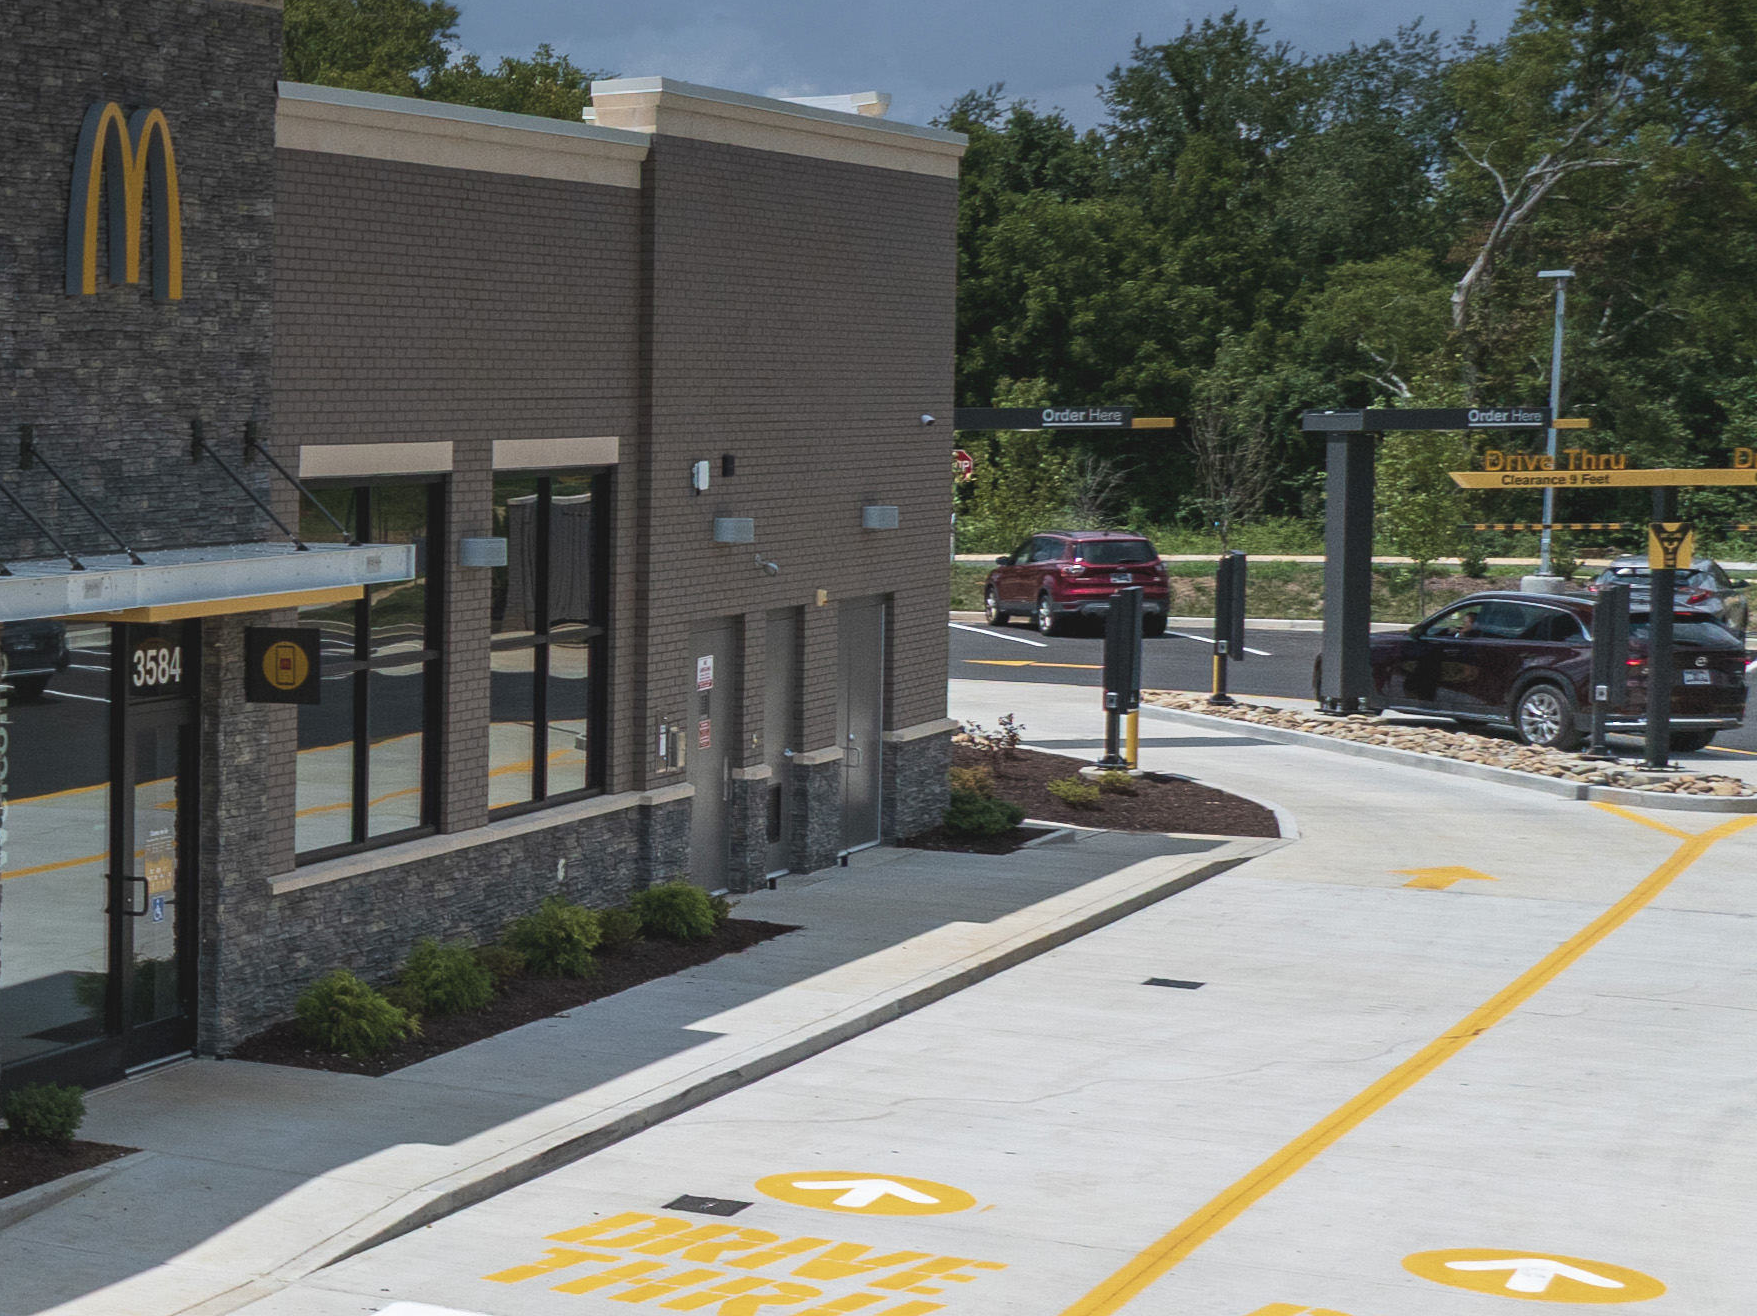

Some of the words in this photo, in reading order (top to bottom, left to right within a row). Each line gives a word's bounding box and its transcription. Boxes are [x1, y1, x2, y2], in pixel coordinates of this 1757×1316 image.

[1042, 408, 1086, 422] Order
[1088, 408, 1123, 422] Here
[1467, 409, 1508, 422] Order
[1511, 409, 1543, 422] Here
[1484, 449, 1555, 472] Drive
[1563, 448, 1627, 471] Thru
[1501, 474, 1567, 486] Clearance
[1569, 474, 1578, 485] 9
[1581, 473, 1611, 485] Feet
[132, 646, 182, 687] 3584
[543, 1211, 1009, 1295] DRIVE
